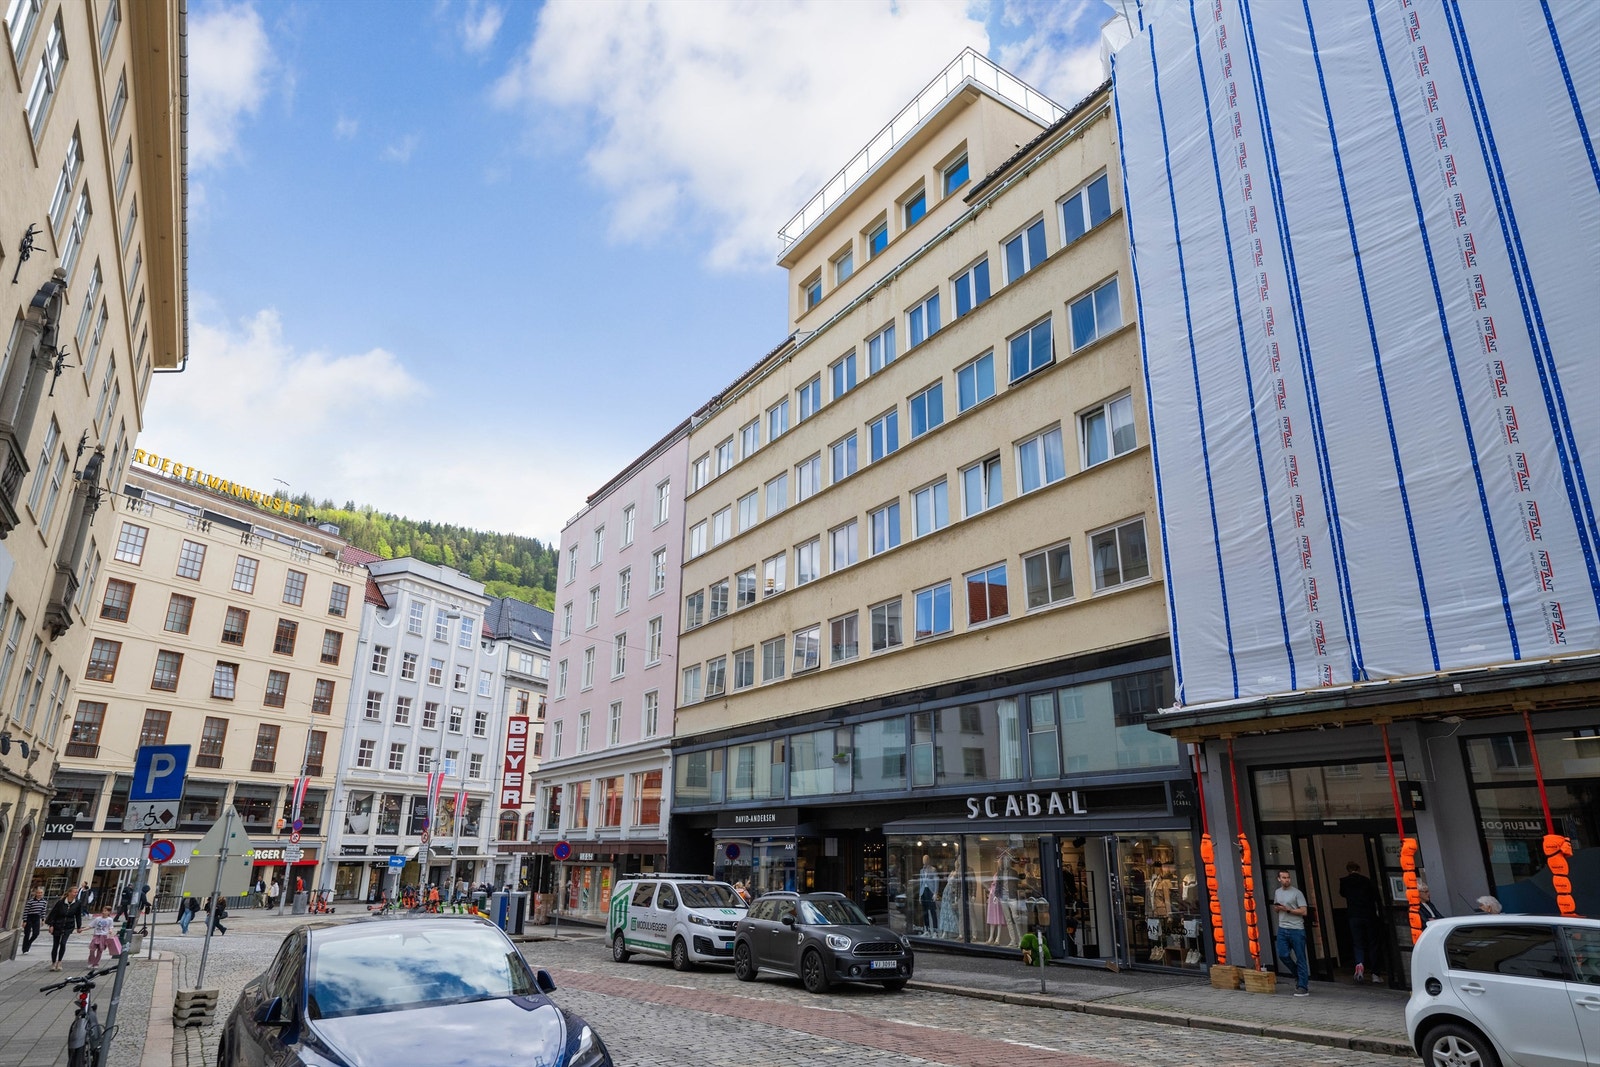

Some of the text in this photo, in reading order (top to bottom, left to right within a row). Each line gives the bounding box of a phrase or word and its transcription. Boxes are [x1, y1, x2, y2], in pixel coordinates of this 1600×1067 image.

[1409, 11, 1421, 41] INSTANT
[1418, 46, 1429, 76] INSTANT
[1426, 81, 1438, 112] INSTANT
[1234, 112, 1242, 138] INSTANT
[1436, 117, 1448, 149] INSTANT
[1244, 174, 1252, 201] INSTANT
[1445, 155, 1457, 187] INSTANT
[1454, 193, 1467, 227] INSTANT
[1255, 239, 1263, 266] INSTANT
[1464, 233, 1477, 267] INSTANT
[1260, 273, 1268, 301] INSTANT
[1474, 275, 1487, 309] INSTANT
[1266, 307, 1274, 336] INSTANT
[1483, 317, 1497, 352] INSTANT
[1272, 343, 1280, 372] INSTANT
[1278, 379, 1286, 410] INSTANT
[1494, 361, 1508, 397] INSTANT
[1283, 417, 1292, 448] INSTANT
[1504, 406, 1519, 443] INSTANT
[134, 448, 302, 516] ROEGELMANNHUSET
[1289, 455, 1298, 487] INSTANT
[1516, 453, 1530, 491] INSTANT
[1296, 495, 1305, 528] INSTANT
[1527, 501, 1542, 541] INSTANT
[1302, 536, 1311, 569] INSTANT
[1539, 551, 1554, 592] INSTANT
[1309, 578, 1318, 612] INSTANT
[1315, 620, 1327, 656] INSTANT
[1550, 602, 1566, 644] INSTANT
[145, 753, 176, 794] P
[502, 721, 527, 804] BEYER
[967, 790, 1087, 818] SCABAL
[99, 858, 150, 866] EUROSK
